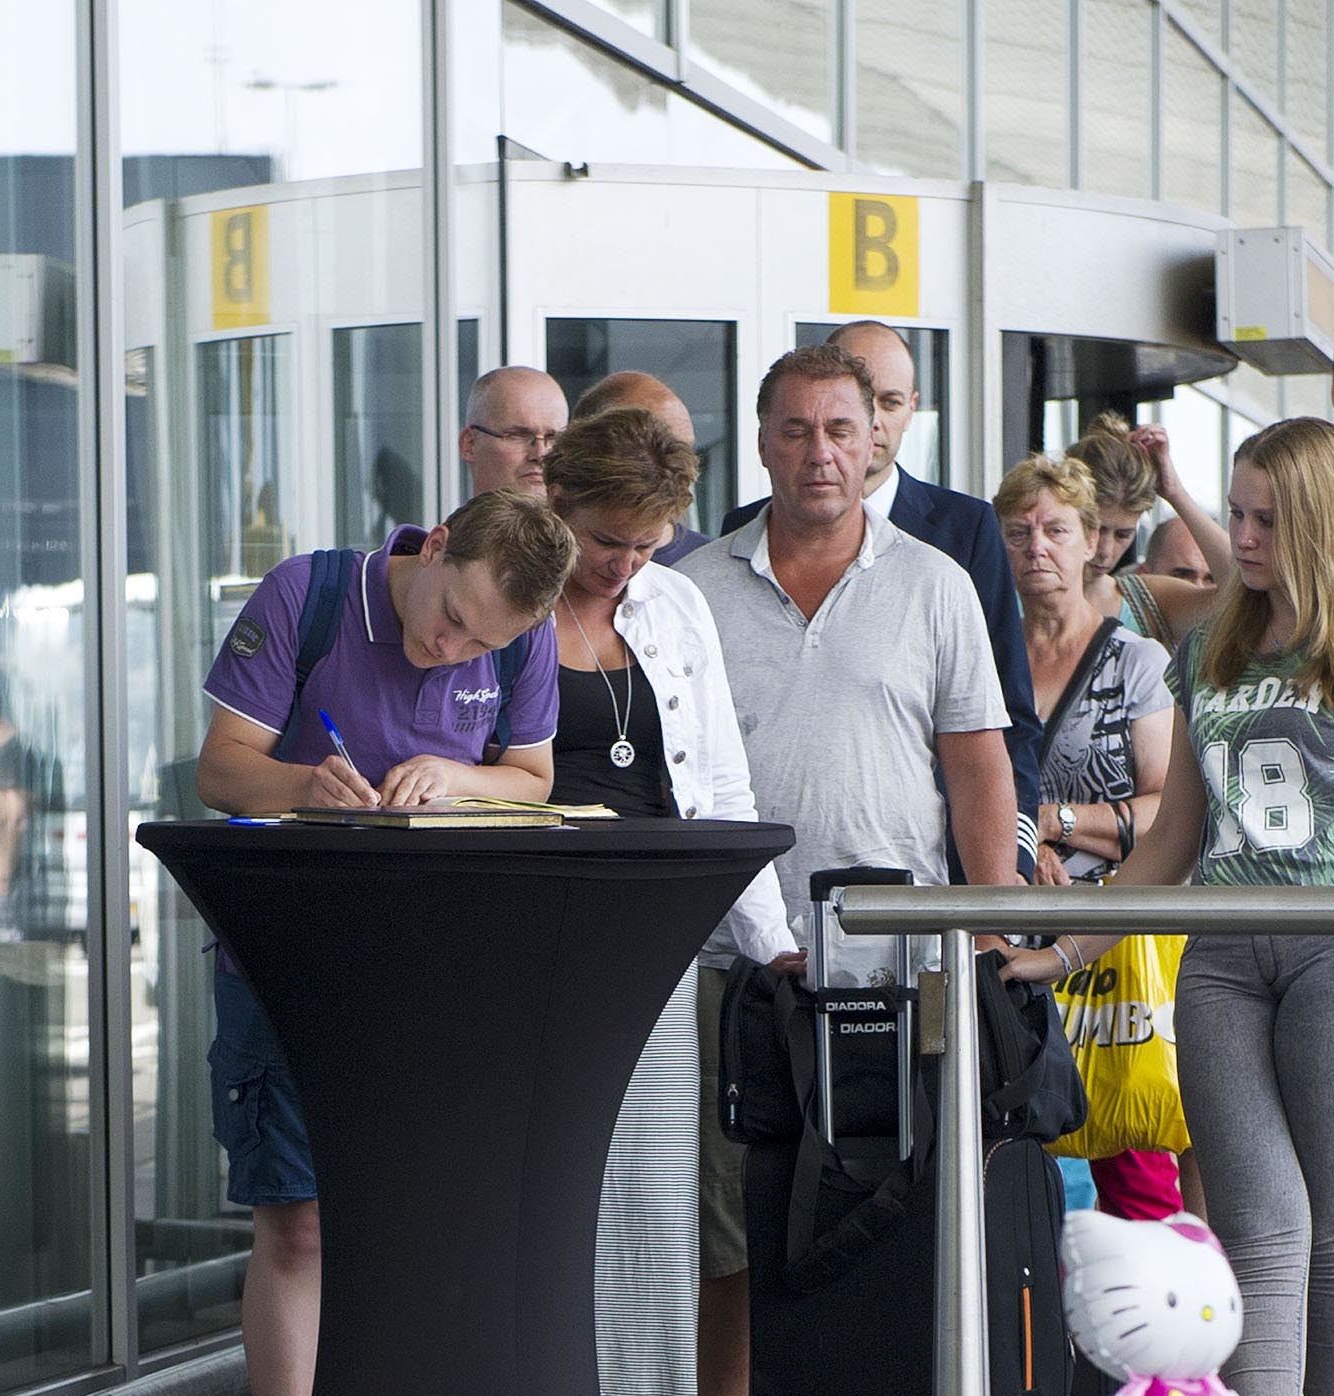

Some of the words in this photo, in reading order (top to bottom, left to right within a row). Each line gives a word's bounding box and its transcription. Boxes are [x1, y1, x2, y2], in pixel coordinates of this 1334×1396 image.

[853, 198, 899, 292] B
[1202, 738, 1314, 858] 18
[825, 1001, 886, 1012] DIADORA
[840, 1022, 898, 1034] DIADOR
